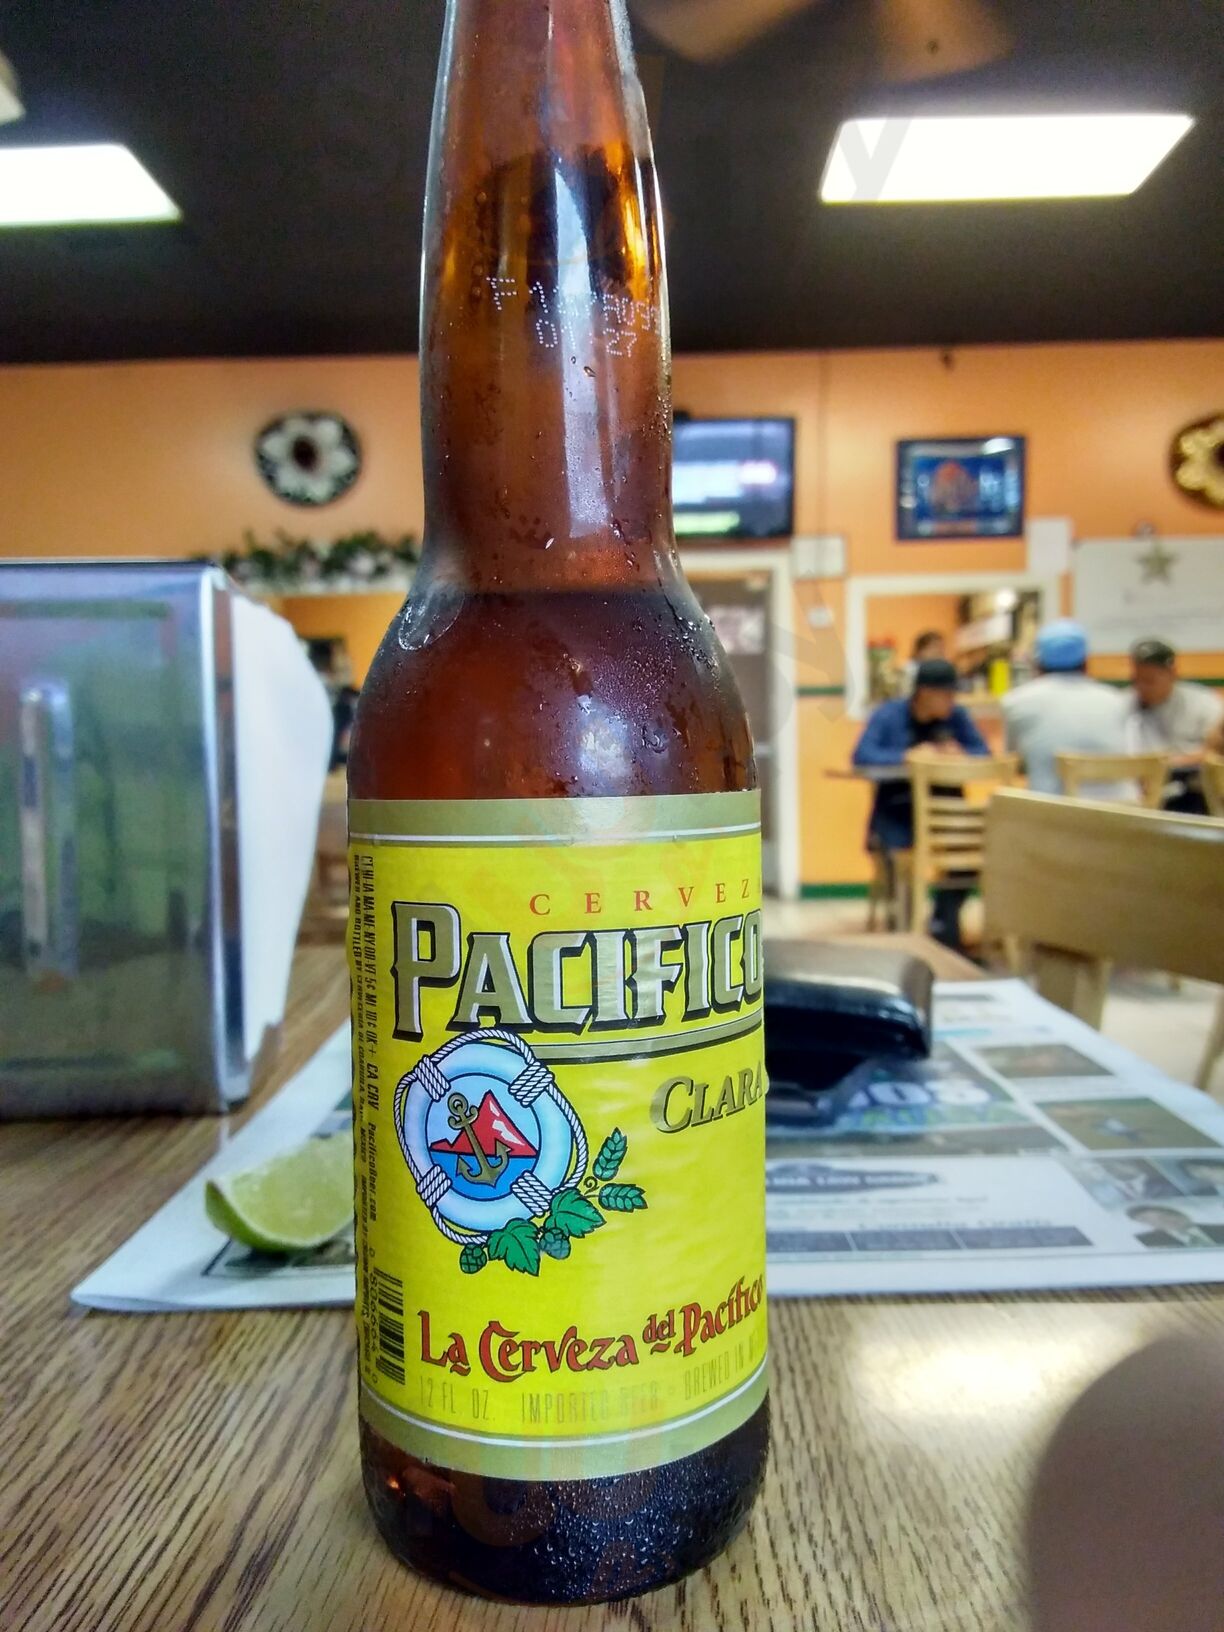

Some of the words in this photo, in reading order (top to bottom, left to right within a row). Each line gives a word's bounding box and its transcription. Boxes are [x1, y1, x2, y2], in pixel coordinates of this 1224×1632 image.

[649, 1060, 763, 1134] CLARA
[418, 1309, 472, 1377] La
[479, 1320, 640, 1383] Cerveza
[642, 1308, 677, 1355] del
[683, 1351, 731, 1401] BREWED
